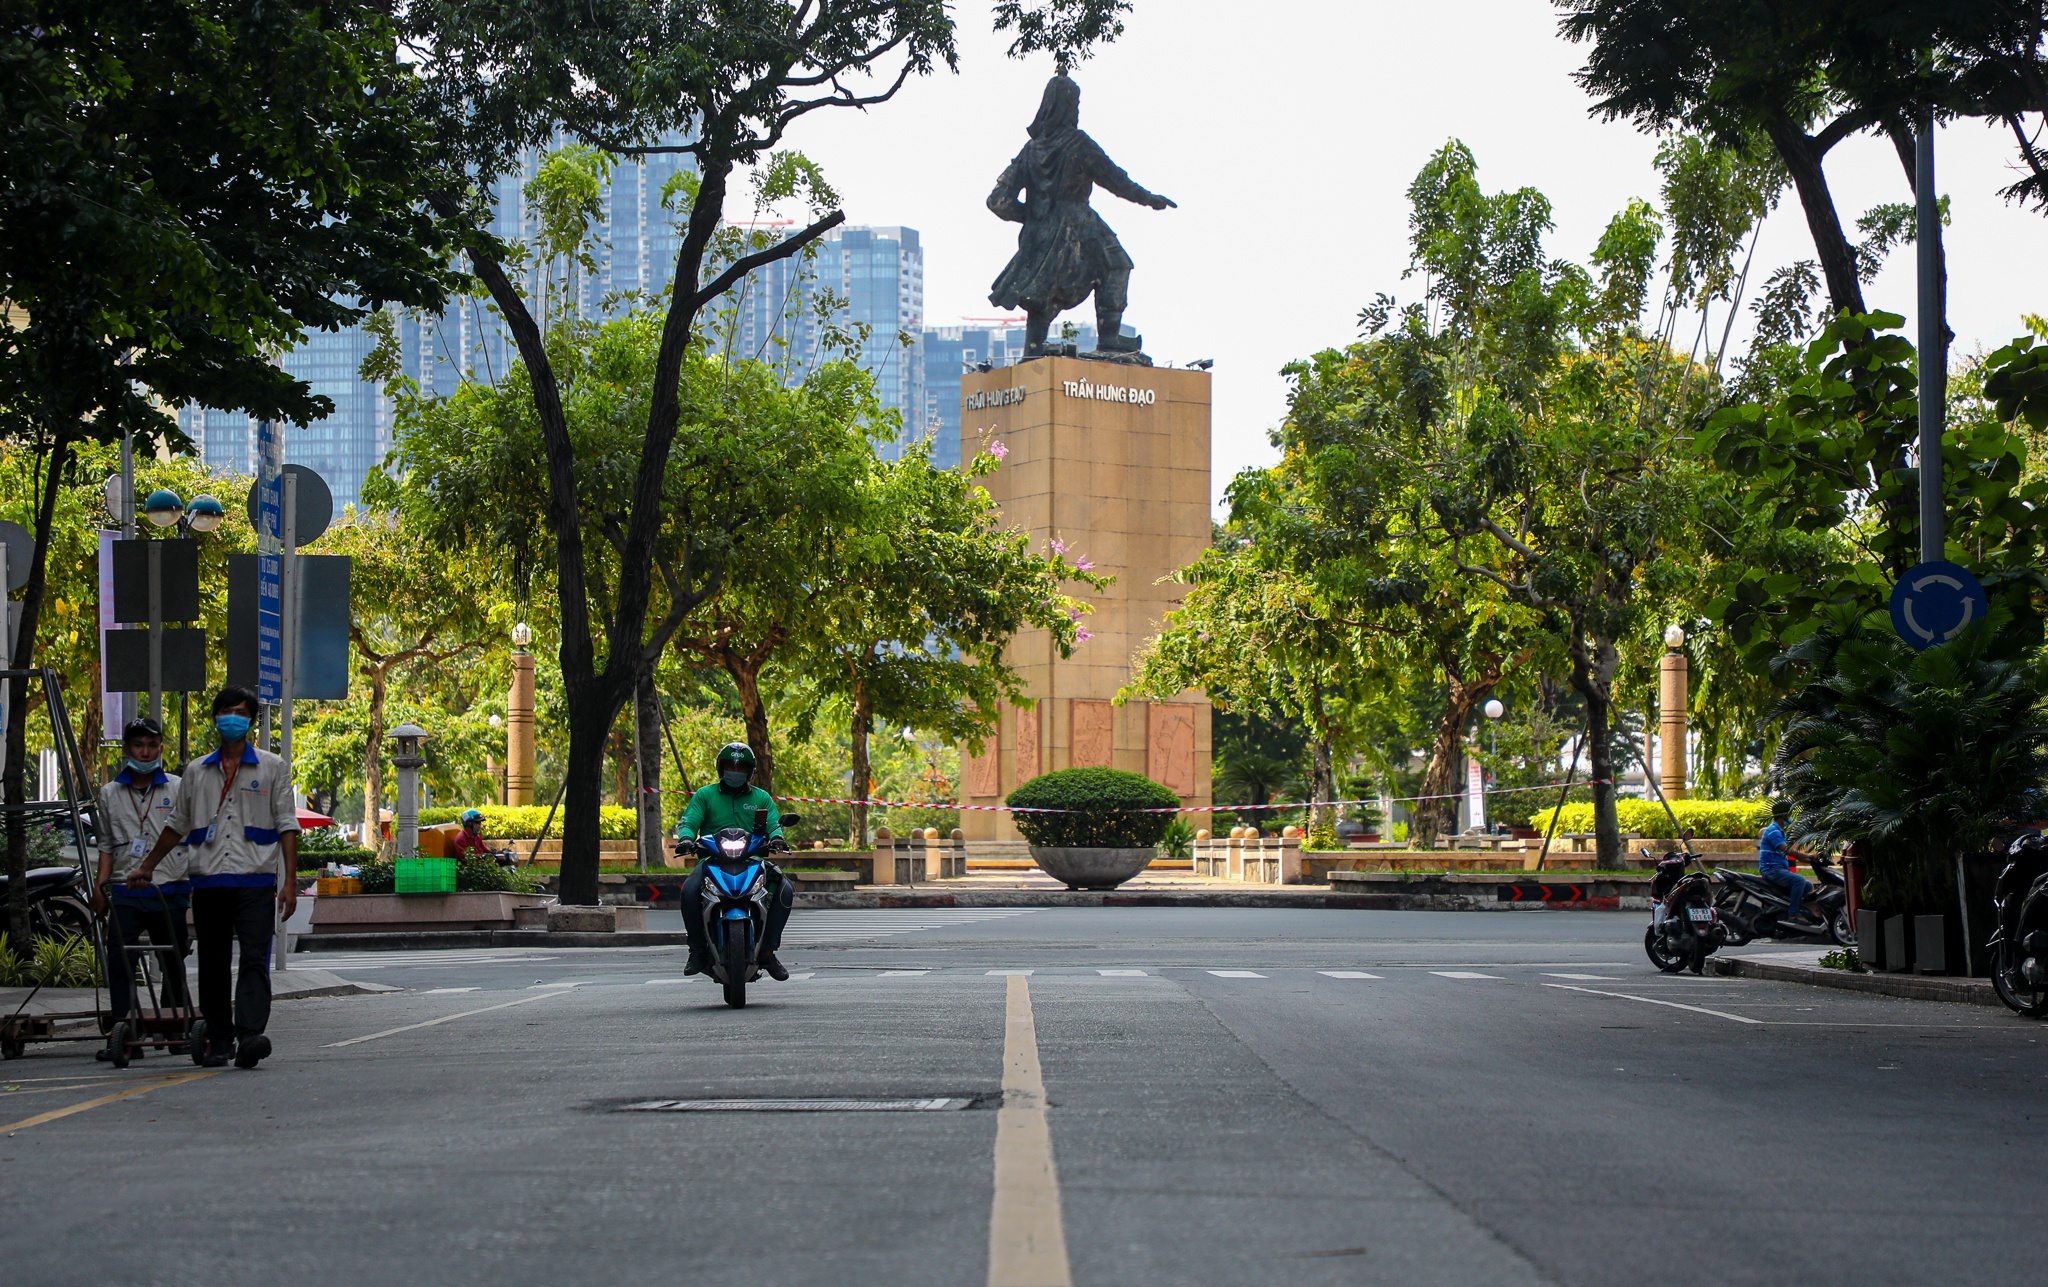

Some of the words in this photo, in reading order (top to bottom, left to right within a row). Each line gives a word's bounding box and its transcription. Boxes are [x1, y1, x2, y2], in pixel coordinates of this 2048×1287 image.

[1063, 377, 1095, 399] TRẦN
[1095, 385, 1127, 402] HƯNG
[1128, 388, 1156, 407] ĐẠO
